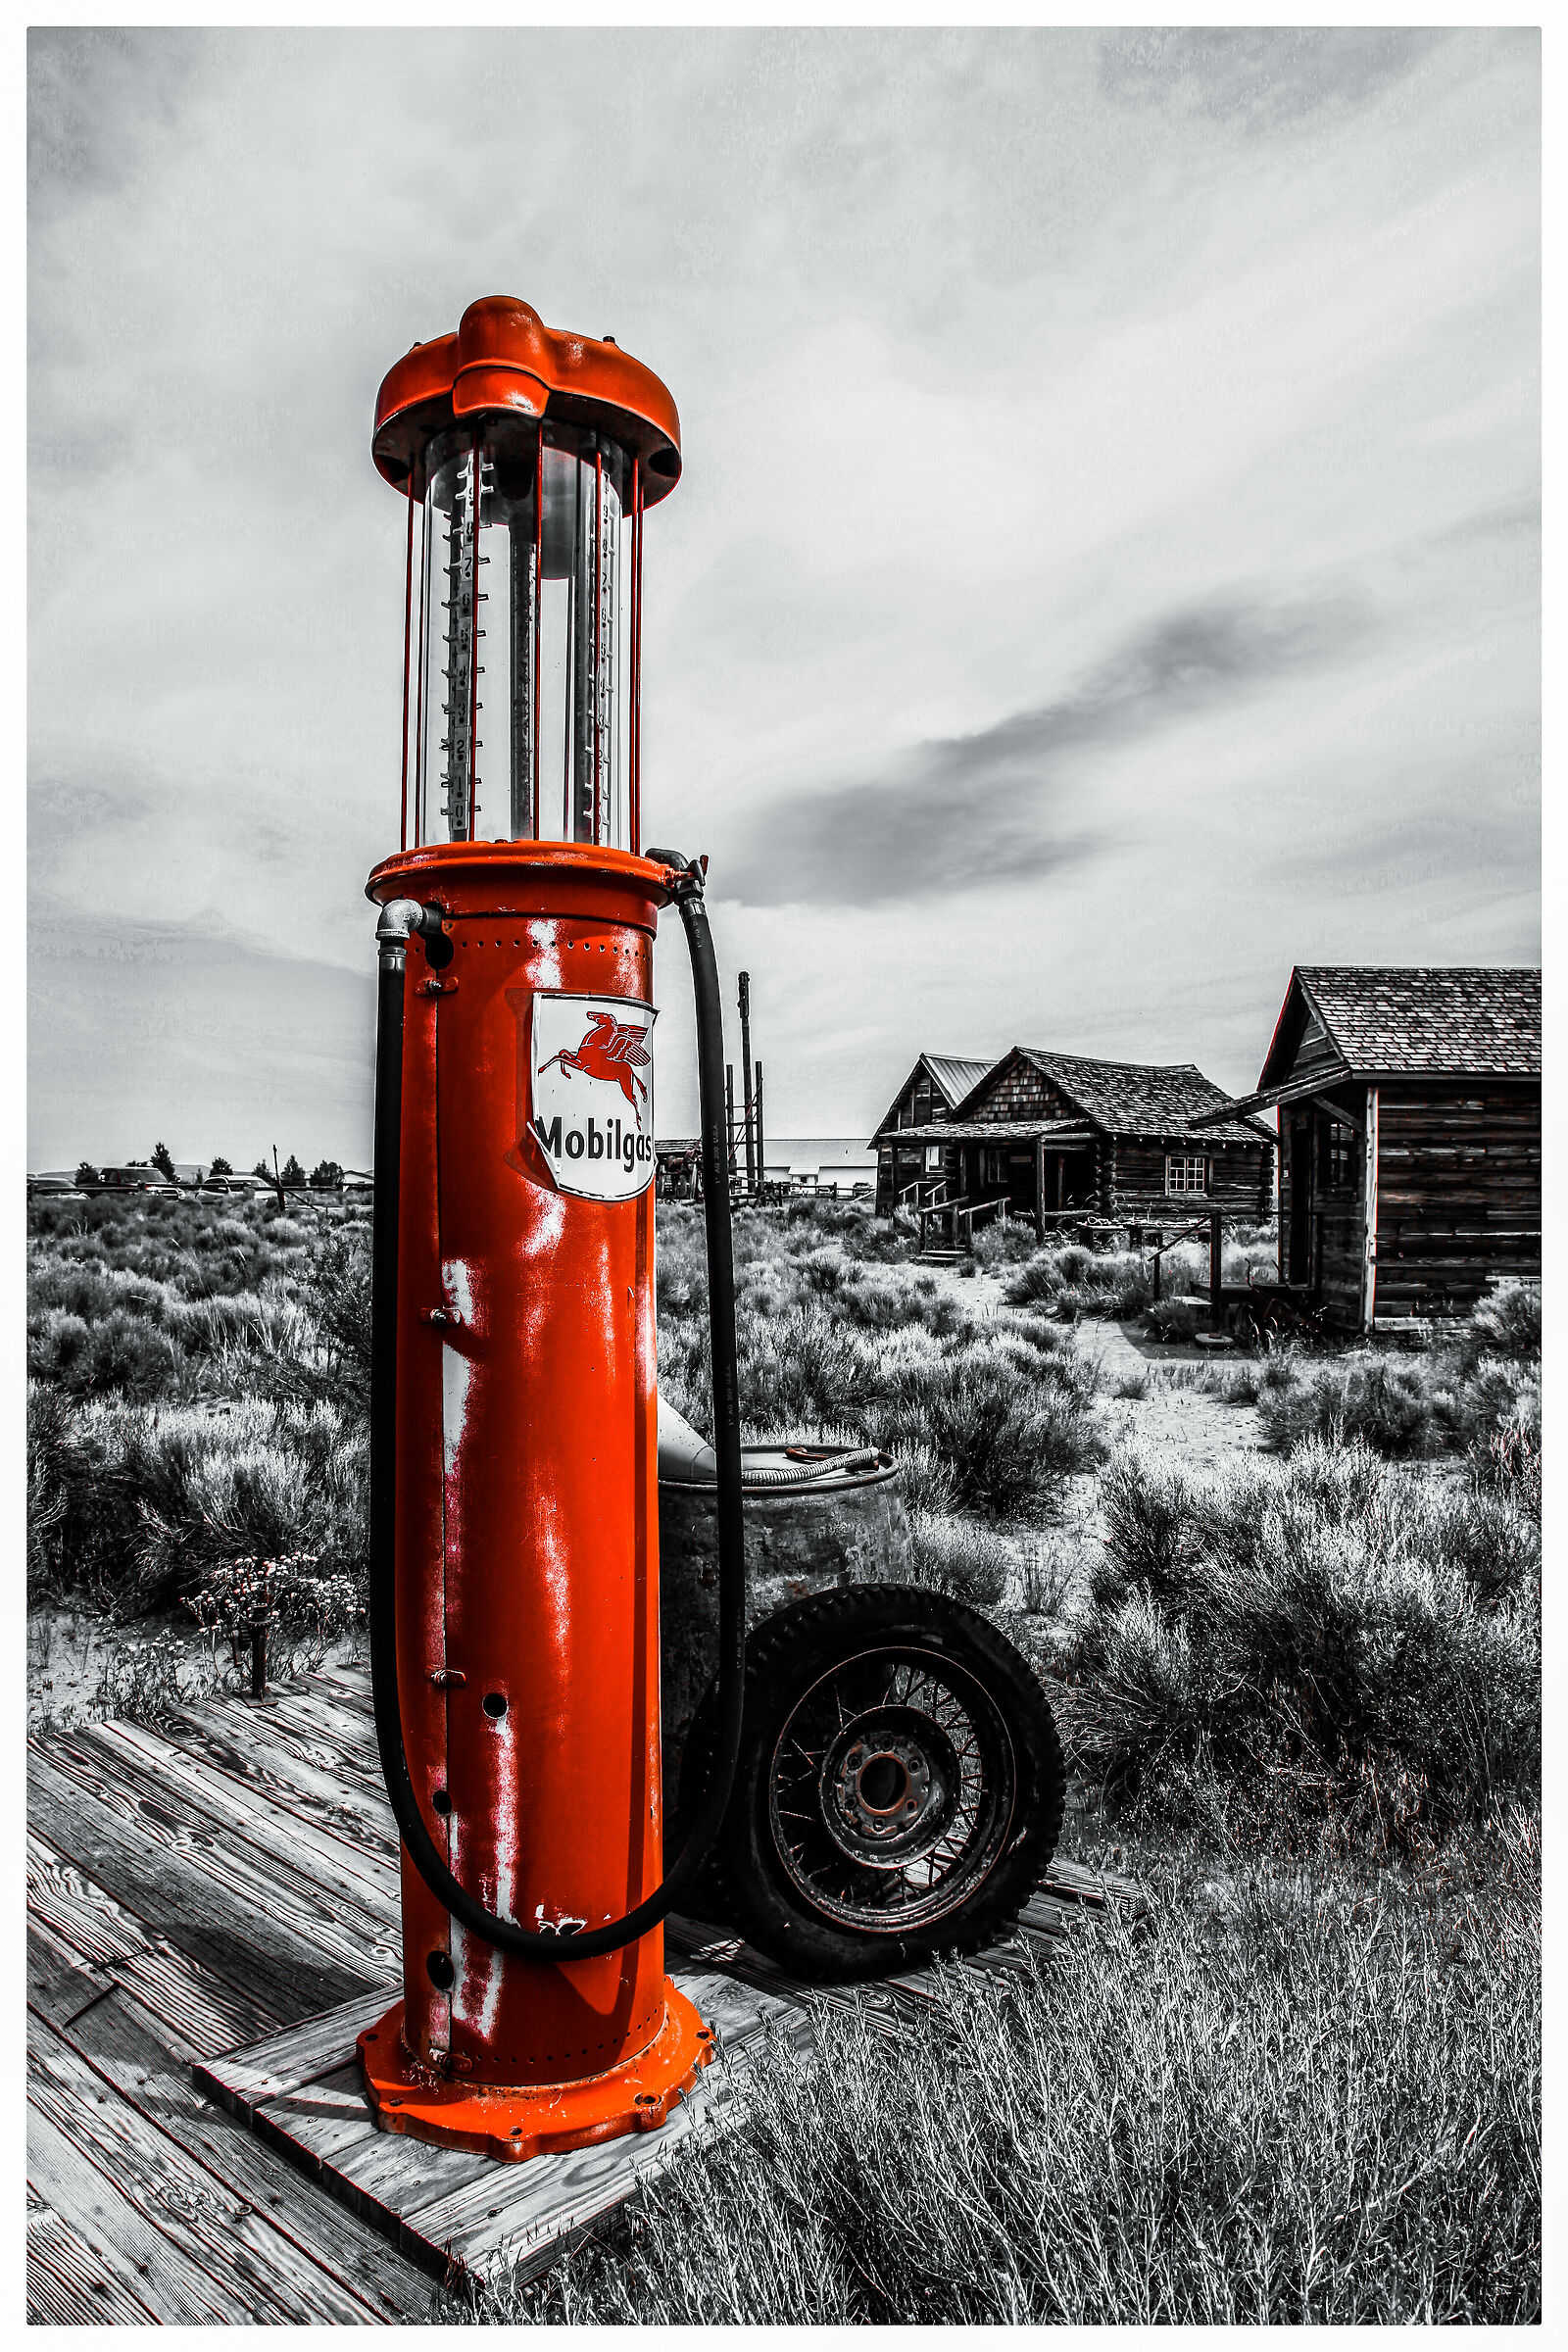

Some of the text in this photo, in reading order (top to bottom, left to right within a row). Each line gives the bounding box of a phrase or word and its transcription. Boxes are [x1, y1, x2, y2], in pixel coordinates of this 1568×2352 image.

[465, 557, 471, 571] 7
[463, 593, 469, 606] 6
[461, 628, 467, 643] 5
[459, 666, 466, 679] 4
[458, 703, 466, 715] 3
[457, 740, 465, 754] 2
[535, 1116, 651, 1172] Mobilgas
